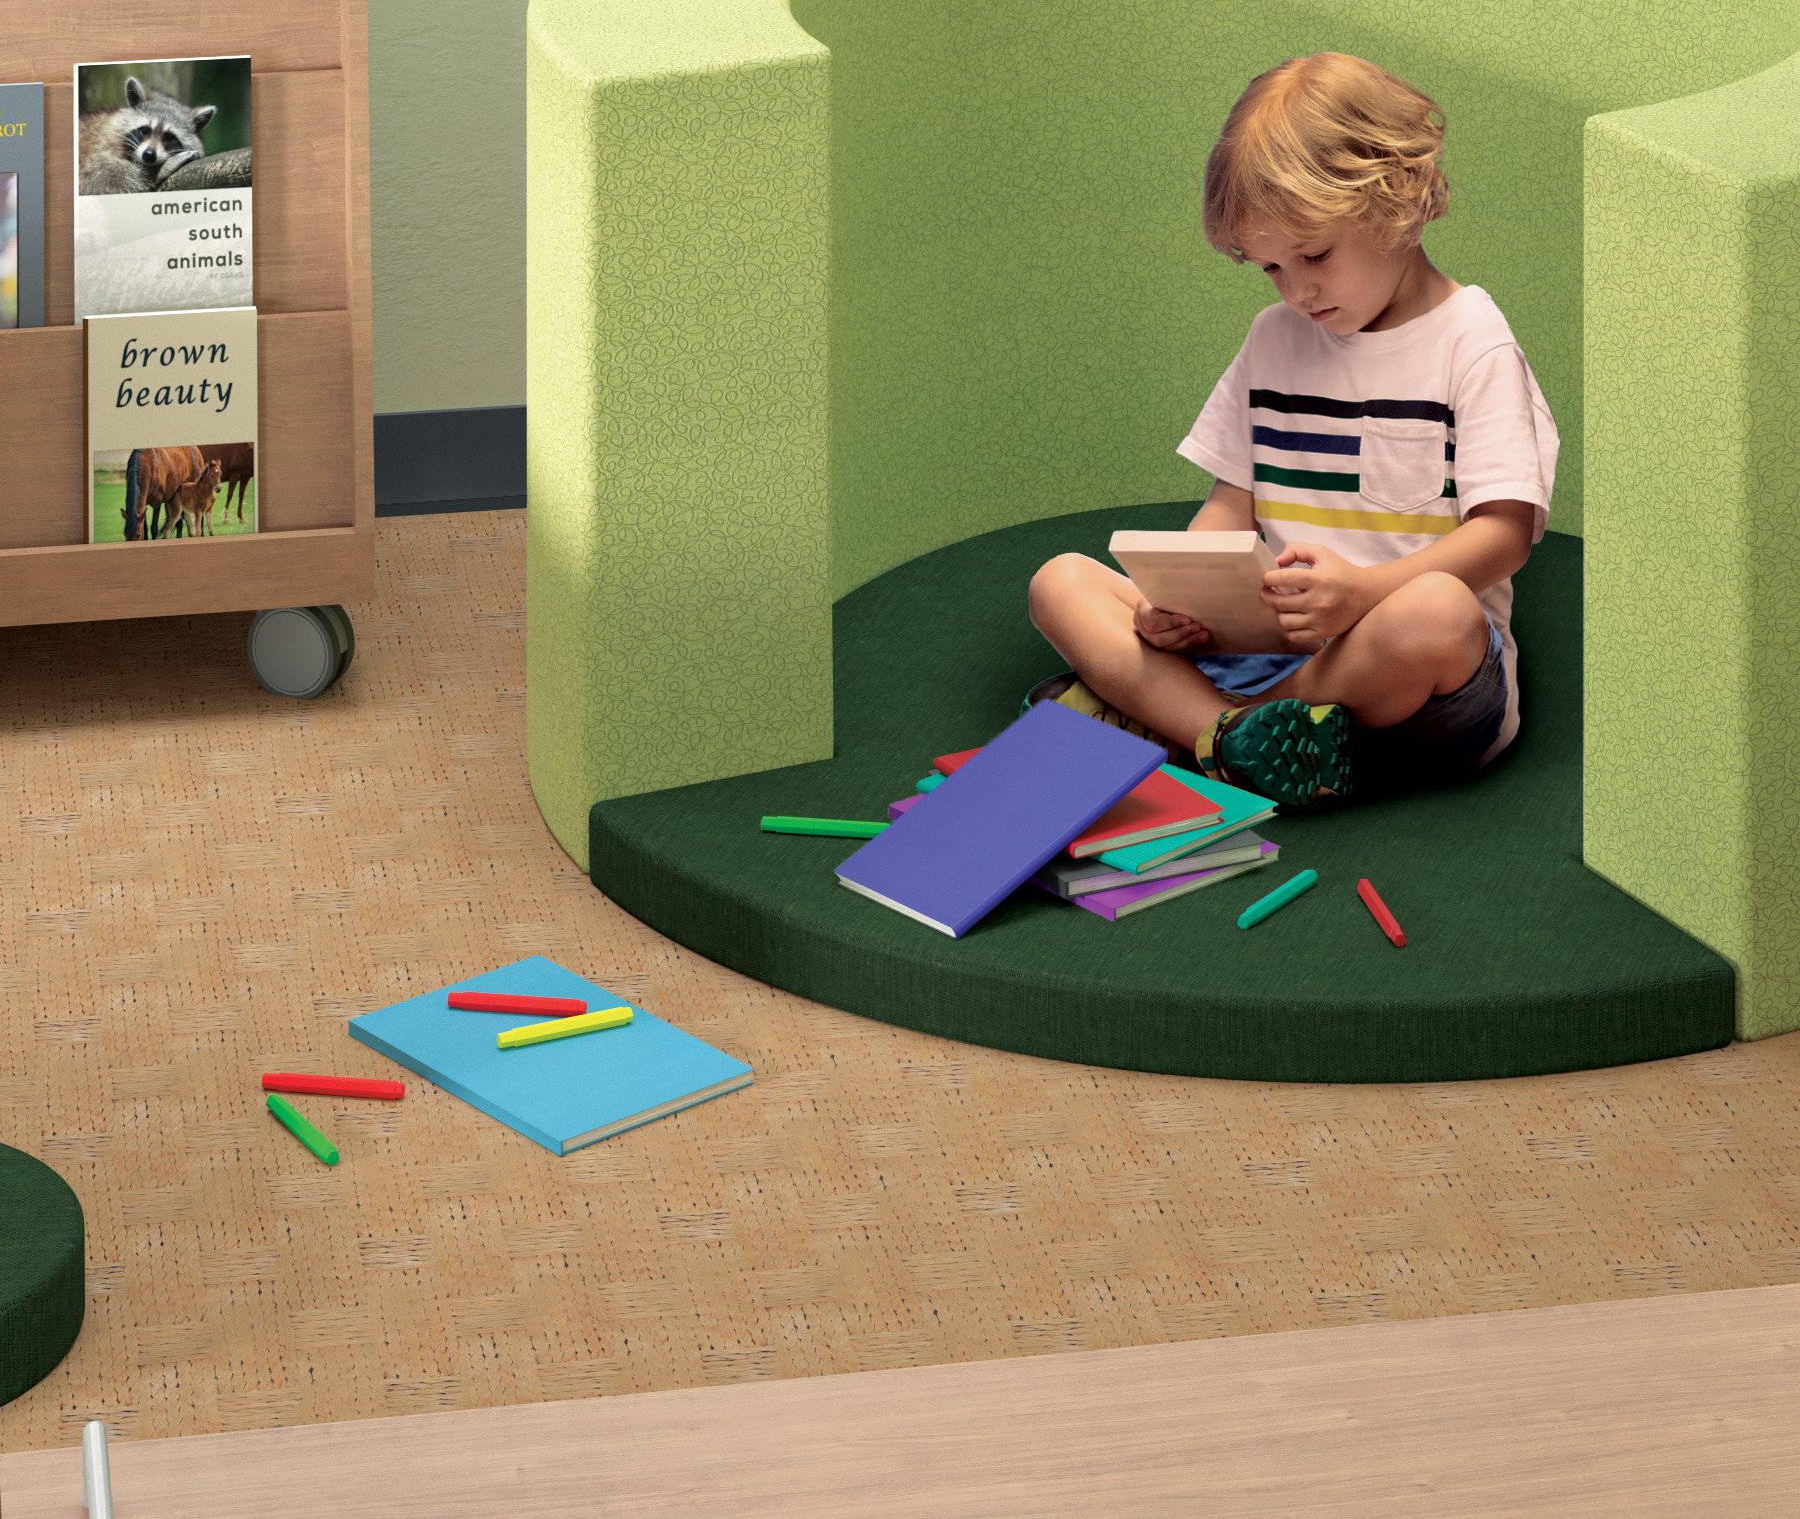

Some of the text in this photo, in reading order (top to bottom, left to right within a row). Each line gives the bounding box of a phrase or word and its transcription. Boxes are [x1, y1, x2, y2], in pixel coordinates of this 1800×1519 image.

[152, 197, 242, 215] american
[189, 223, 242, 240] south
[168, 251, 243, 269] animals
[120, 338, 230, 368] brown
[116, 377, 234, 413] beauty
